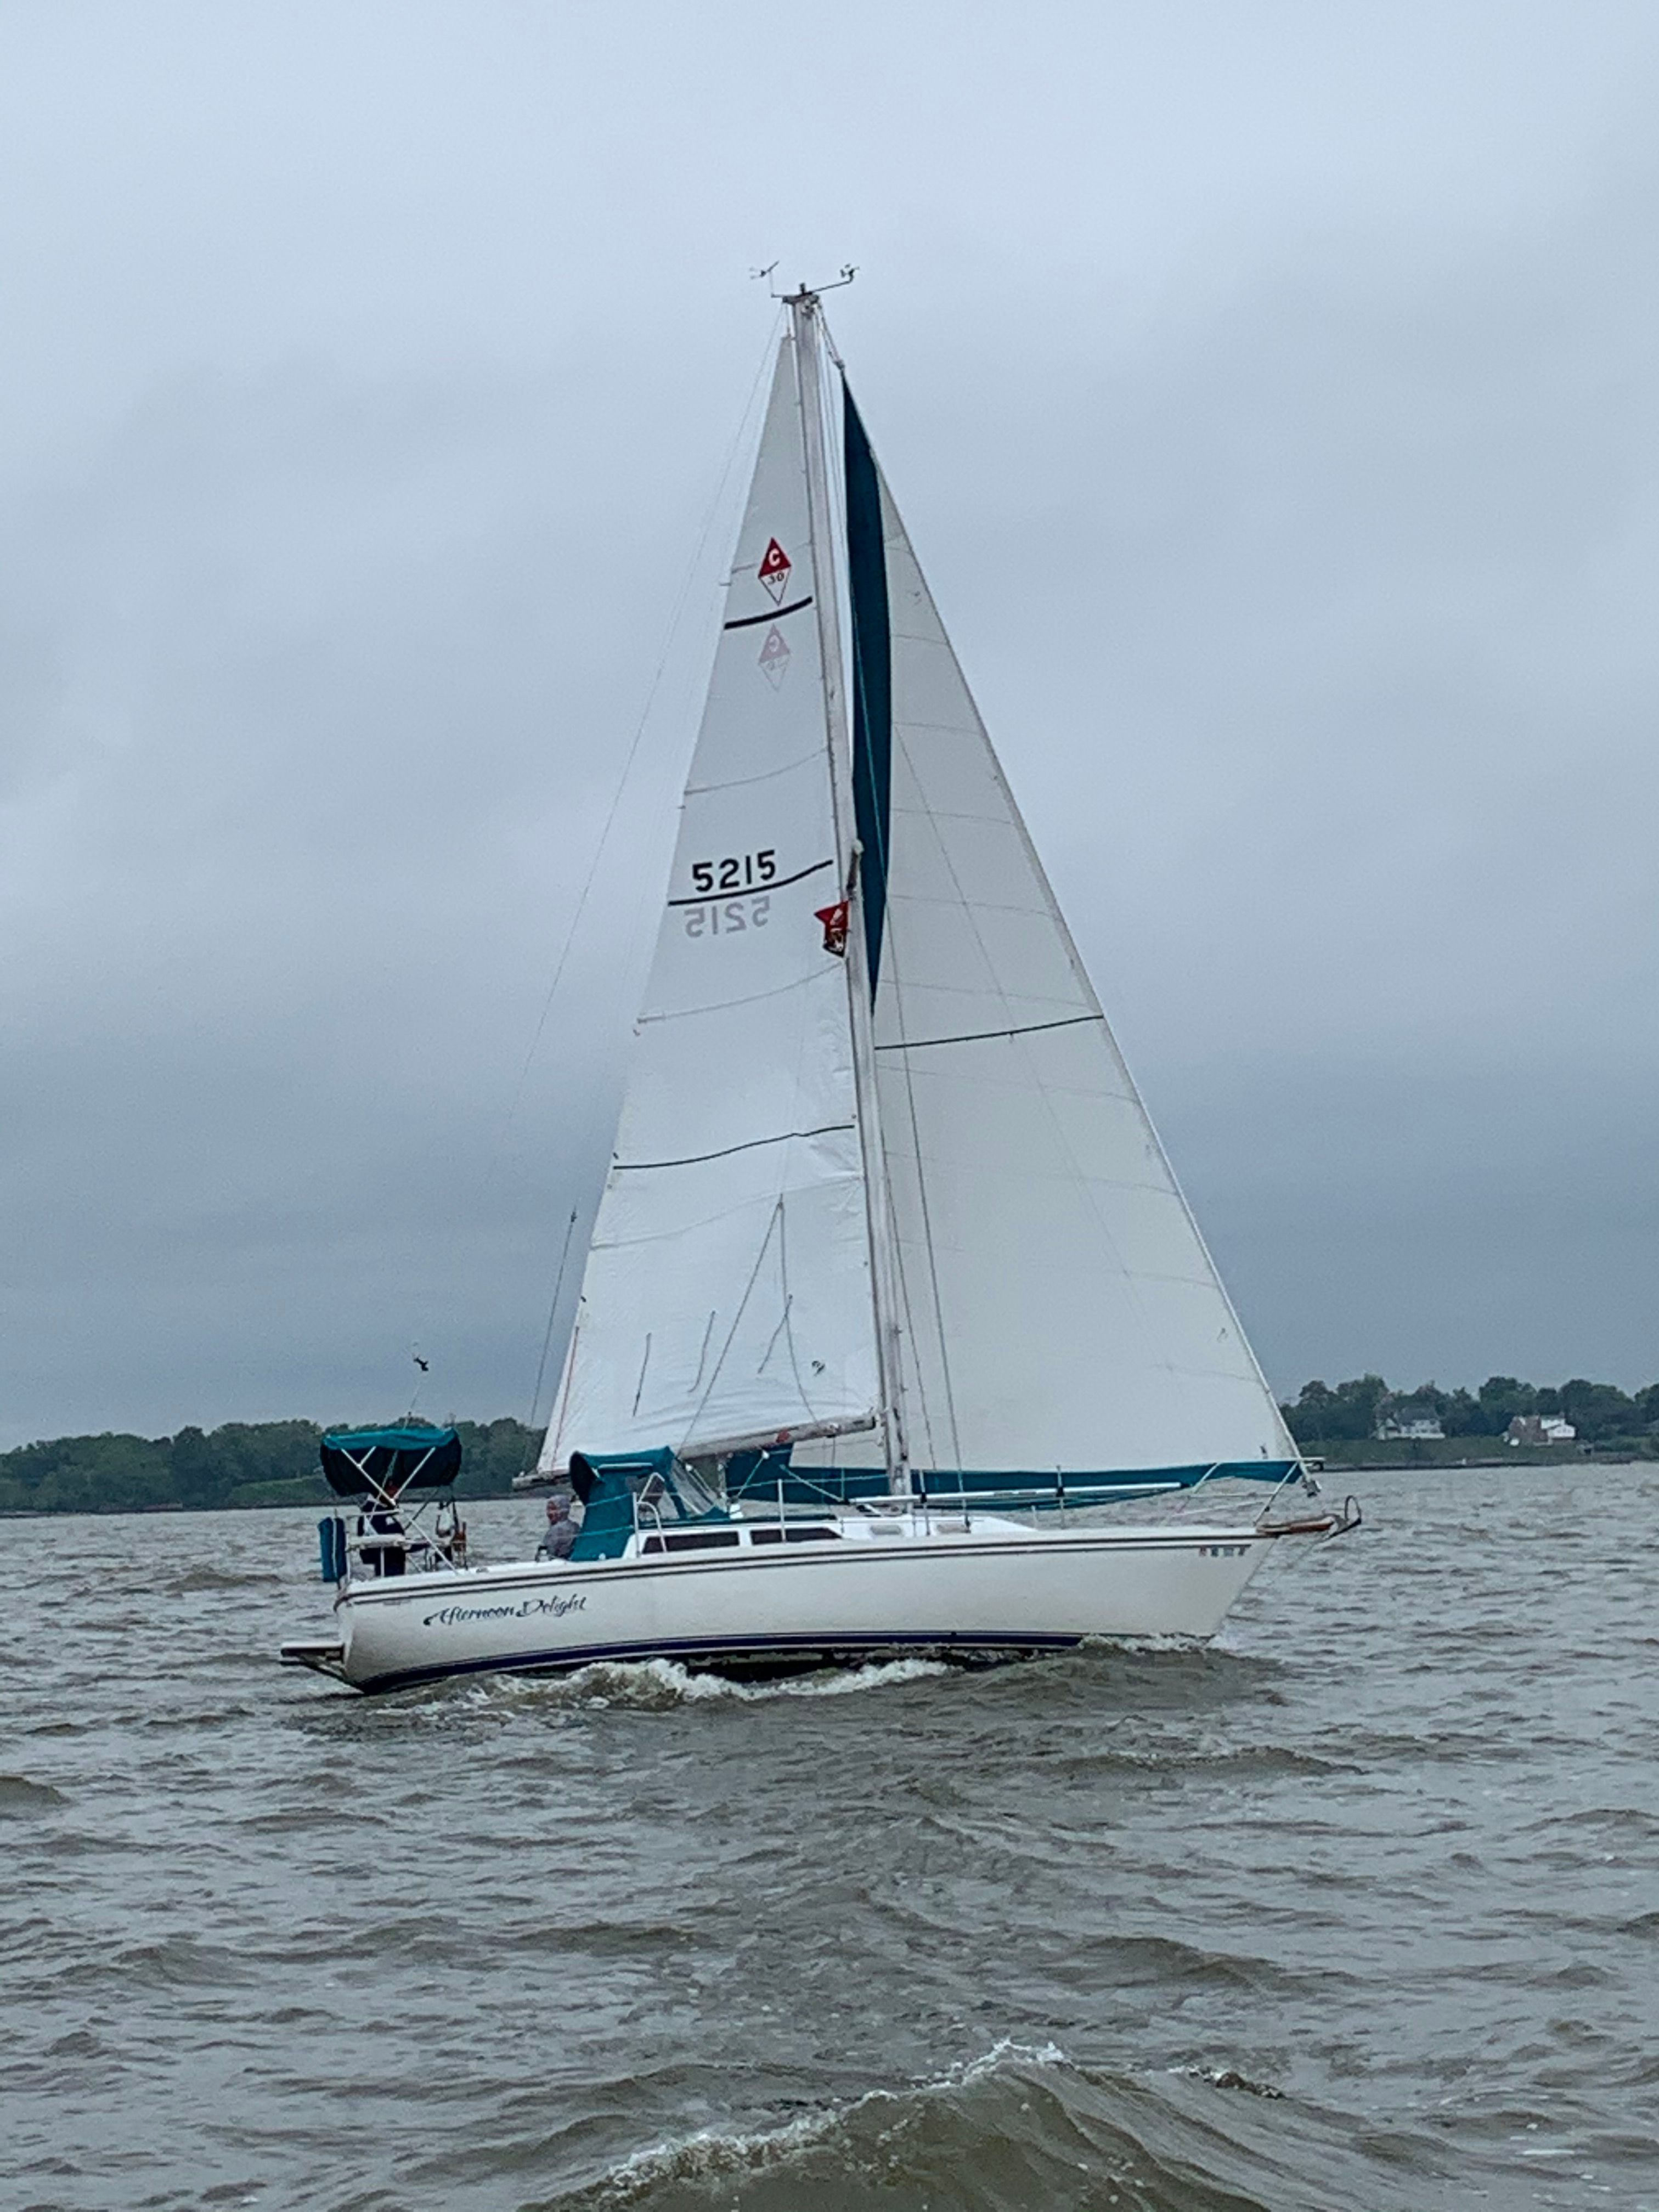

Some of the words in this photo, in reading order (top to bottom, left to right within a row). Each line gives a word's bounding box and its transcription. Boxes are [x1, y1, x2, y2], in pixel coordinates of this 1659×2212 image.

[768, 548, 781, 567] C
[692, 850, 775, 891] 5215
[423, 1606, 514, 1626] Afternoon
[516, 1593, 586, 1617] Delight
